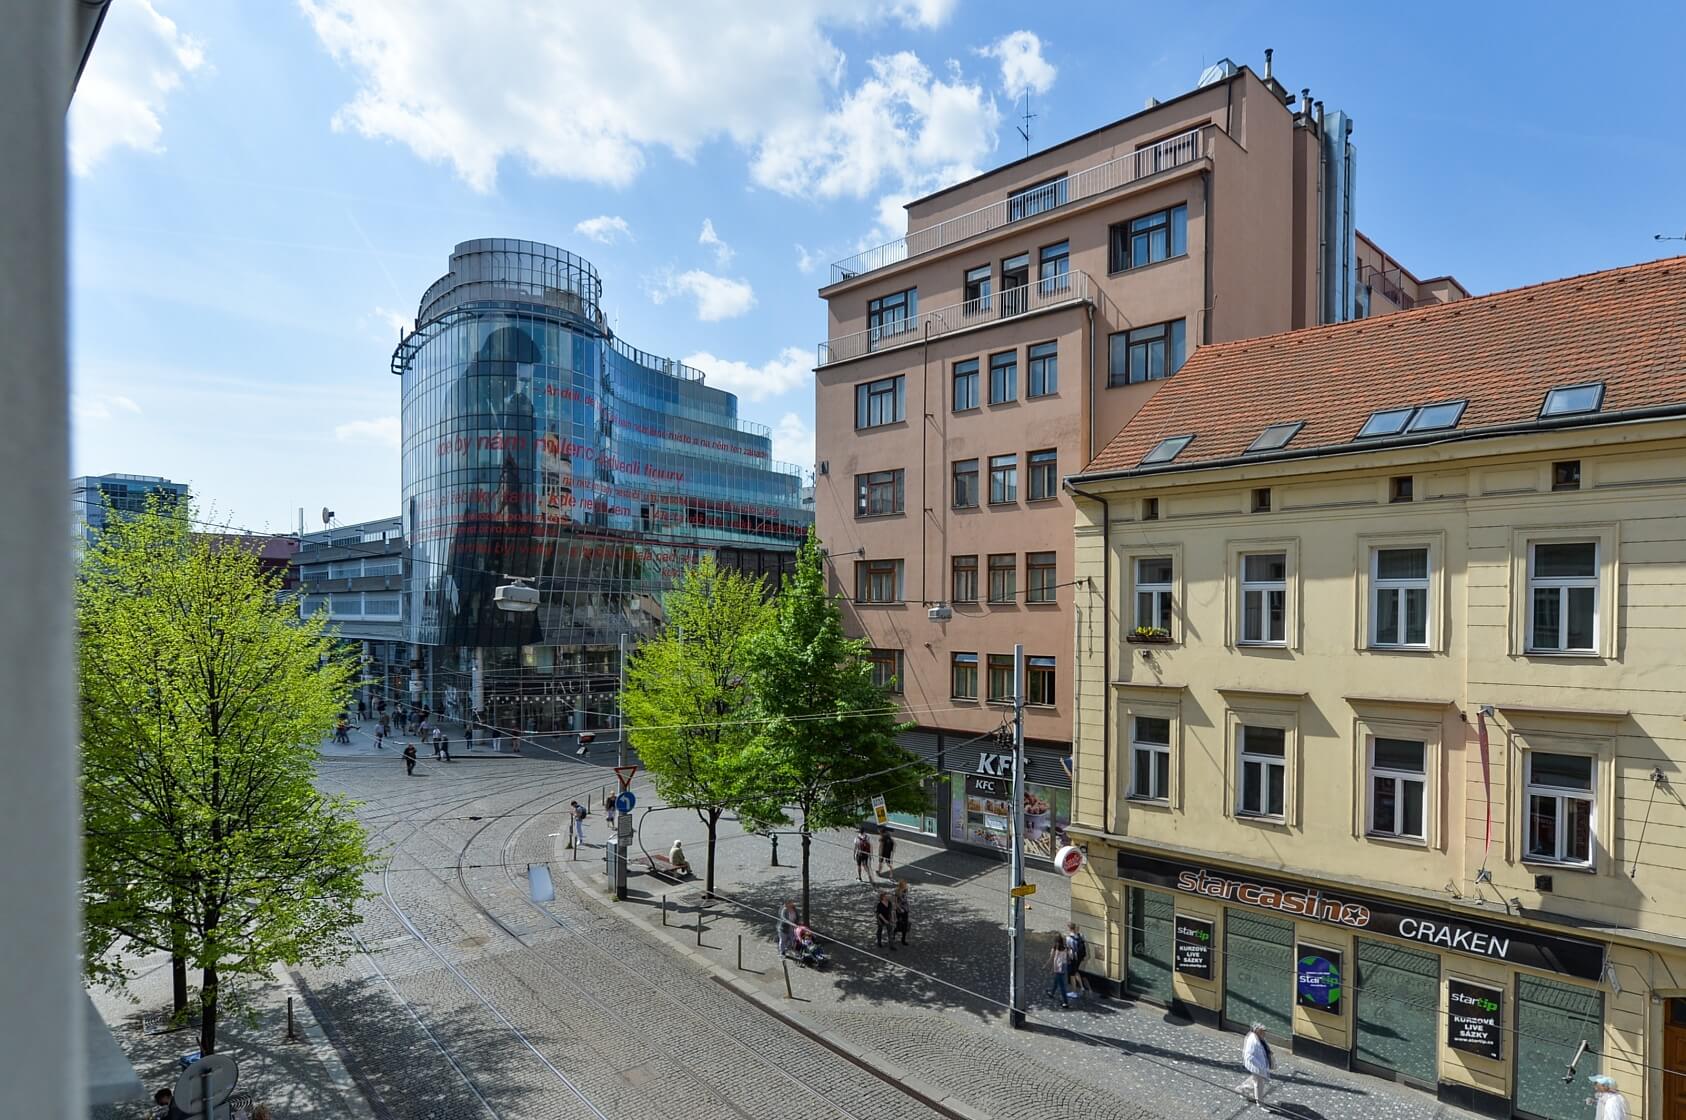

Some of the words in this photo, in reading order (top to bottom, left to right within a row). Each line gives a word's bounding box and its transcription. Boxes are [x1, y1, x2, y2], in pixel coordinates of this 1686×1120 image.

[975, 779, 995, 791] KFC
[1177, 869, 1371, 927] starcasino
[1177, 926, 1209, 941] startip
[1399, 918, 1510, 958] CRAKEN
[1451, 993, 1498, 1012] startip
[1454, 1015, 1495, 1026] KURZOVÉ
[1464, 1023, 1484, 1032] LIVE
[1459, 1030, 1489, 1039] SÁZKY
